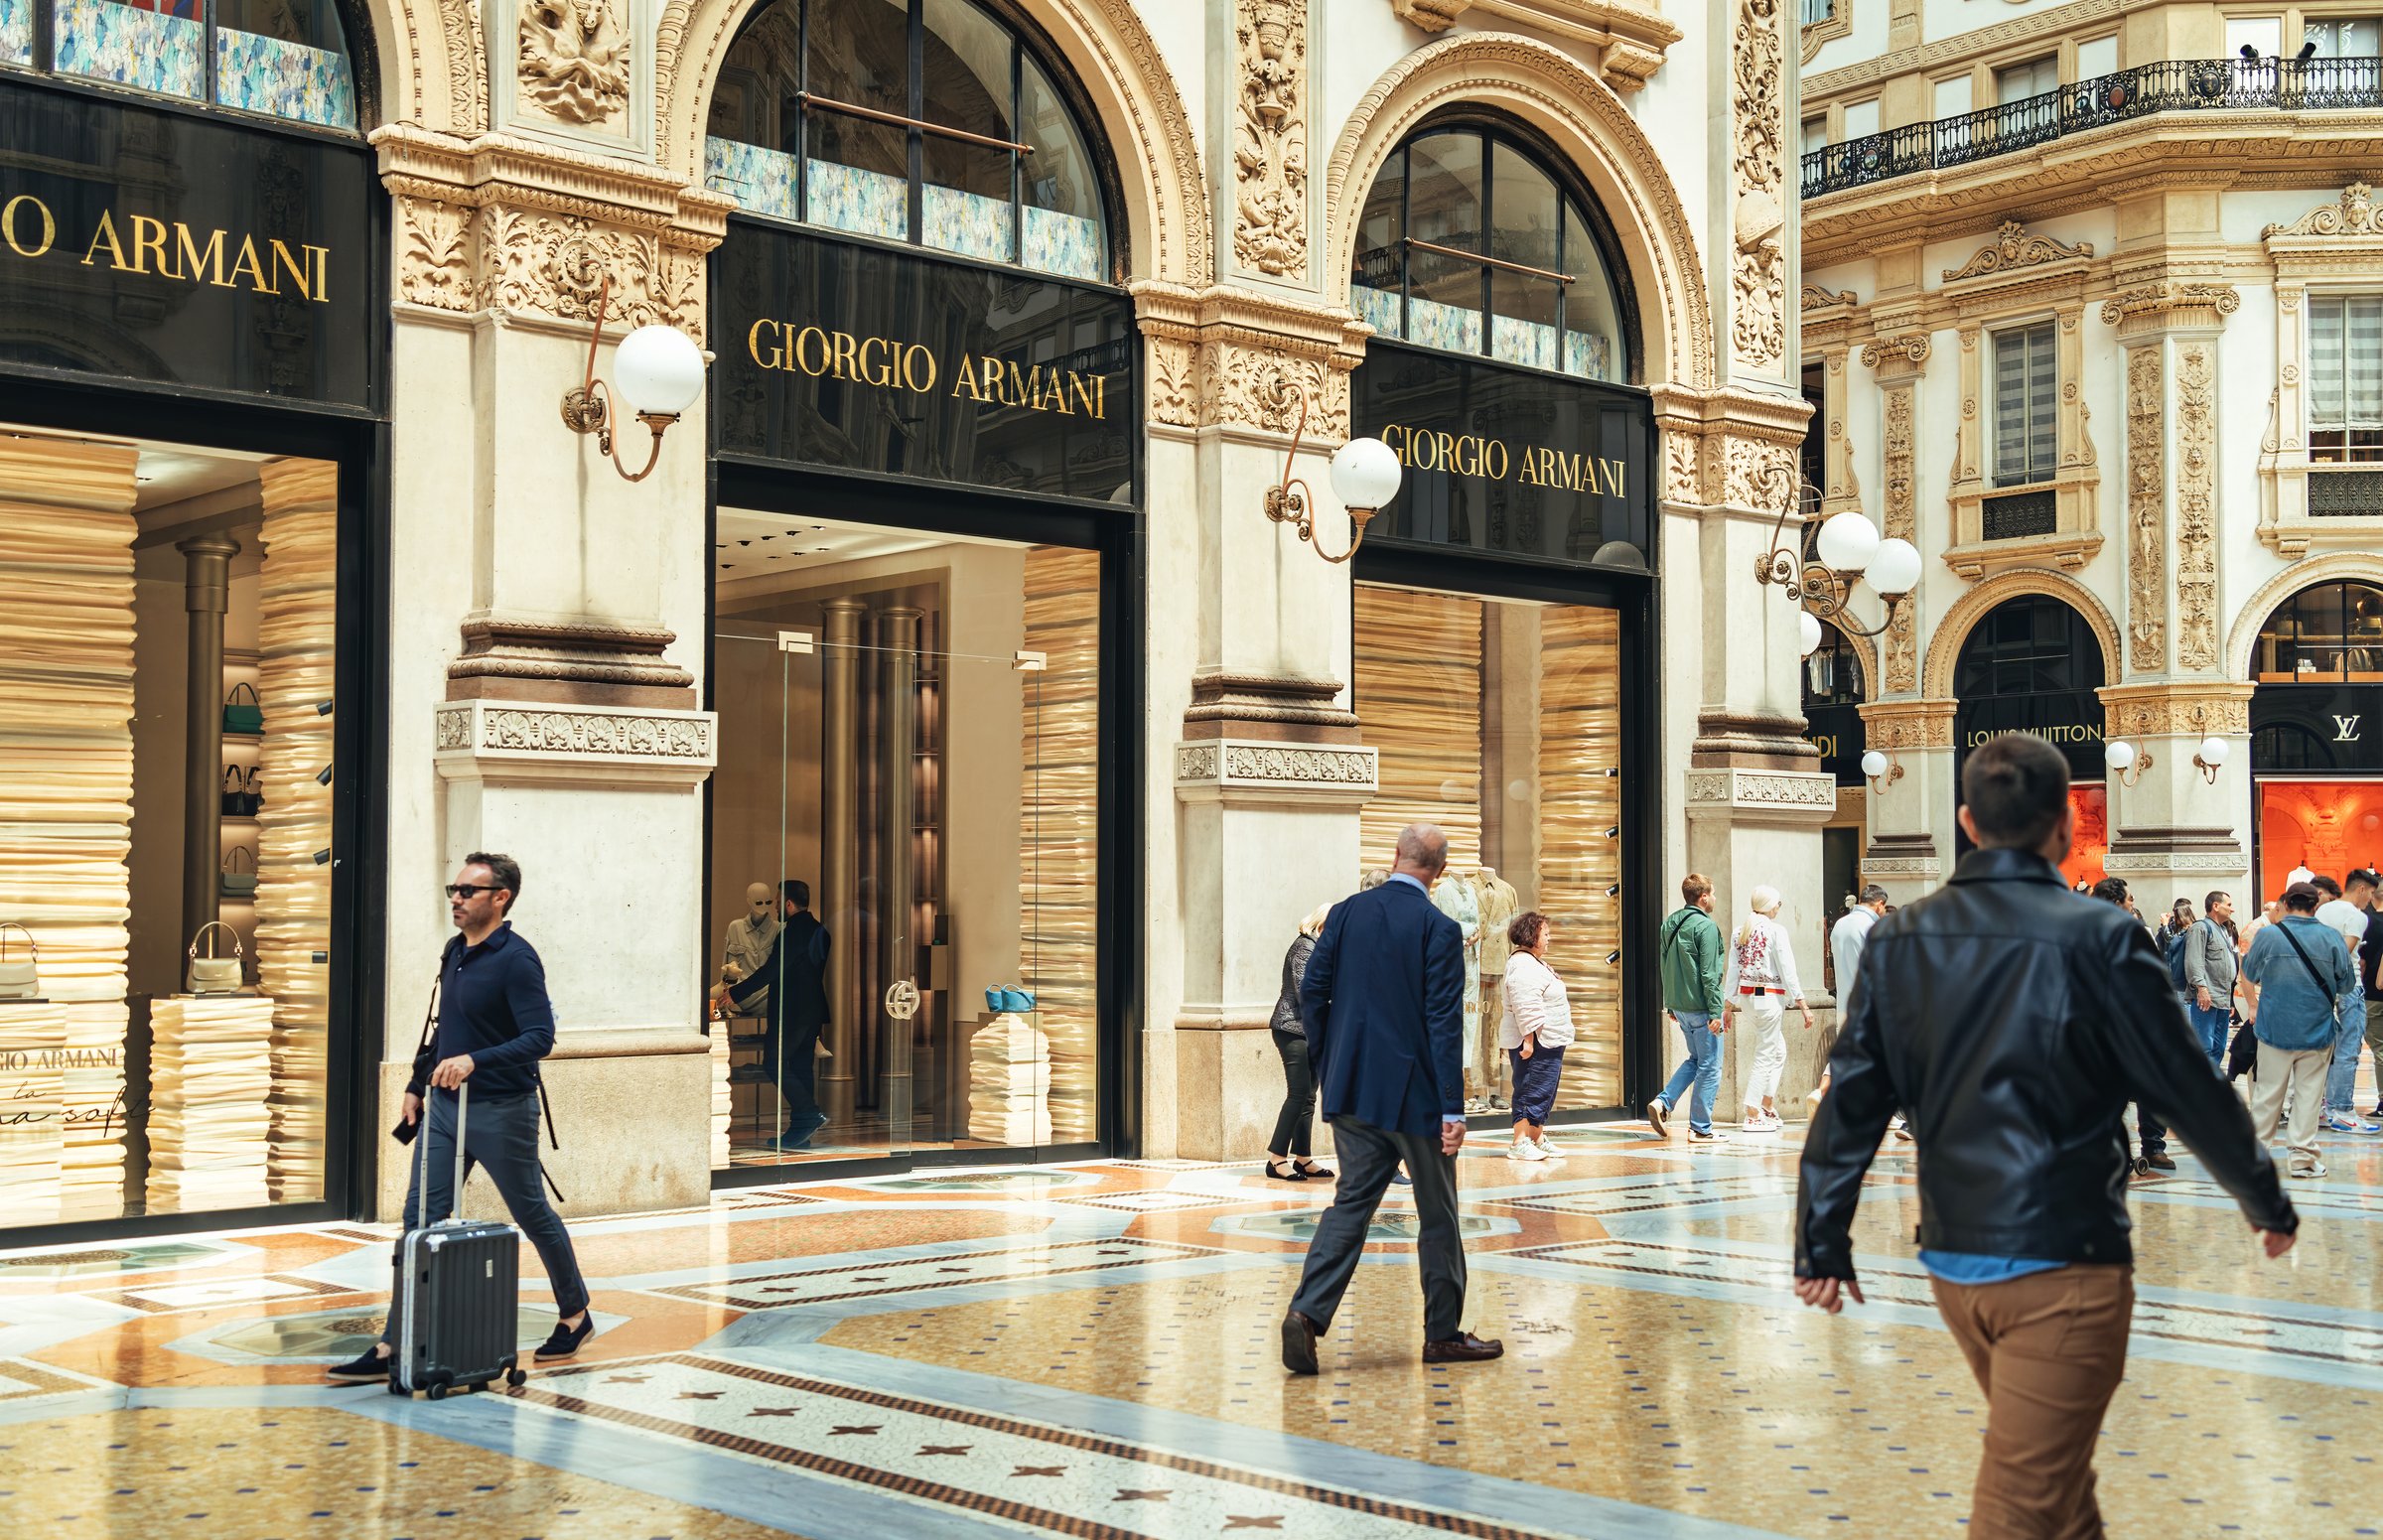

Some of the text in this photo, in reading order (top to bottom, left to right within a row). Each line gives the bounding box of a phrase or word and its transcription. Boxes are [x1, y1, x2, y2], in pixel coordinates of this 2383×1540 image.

[80, 209, 330, 303] ARMANI
[748, 318, 1106, 420] GIORGIO ARMANI
[1381, 424, 1626, 498] GIORGIO ARMANI
[36, 1048, 117, 1070] ARMANI
